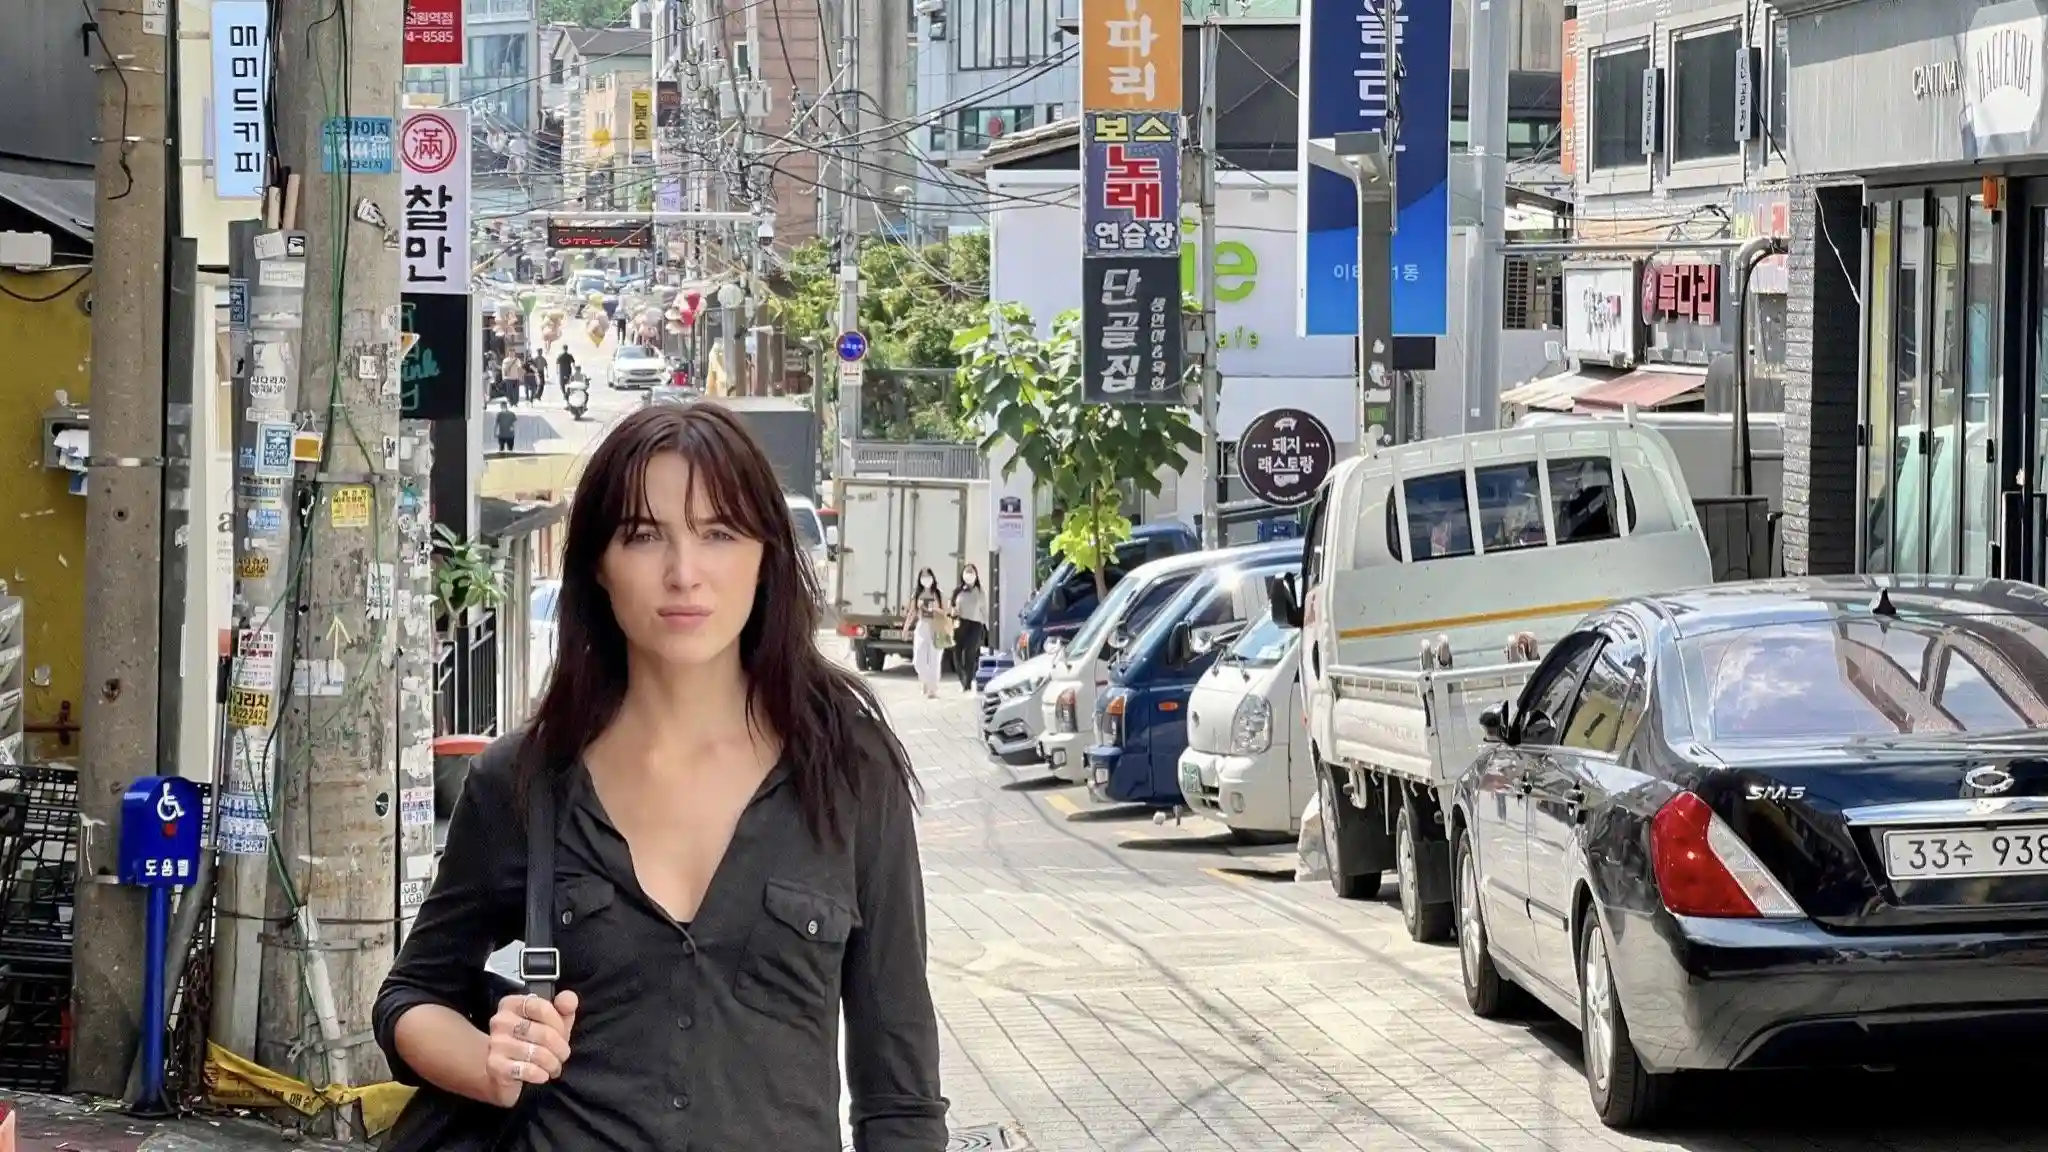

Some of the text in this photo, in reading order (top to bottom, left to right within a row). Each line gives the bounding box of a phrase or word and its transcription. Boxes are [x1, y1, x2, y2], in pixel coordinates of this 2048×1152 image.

[404, 31, 454, 43] 4-8585
[1104, 0, 1159, 102] 다리
[1912, 61, 1960, 97] CANTINA
[1977, 29, 2033, 103] HACIENDA
[412, 128, 444, 160] 滿
[1094, 117, 1172, 142] 보스
[1103, 144, 1162, 221] 노래
[405, 184, 453, 282] 찰만
[1094, 222, 1176, 249] 연습장
[1101, 268, 1142, 394] 단골집
[1271, 436, 1301, 455] 돼지
[1745, 785, 1806, 800] SM5
[145, 859, 189, 877] 도움벨
[1908, 838, 1973, 869] 33수
